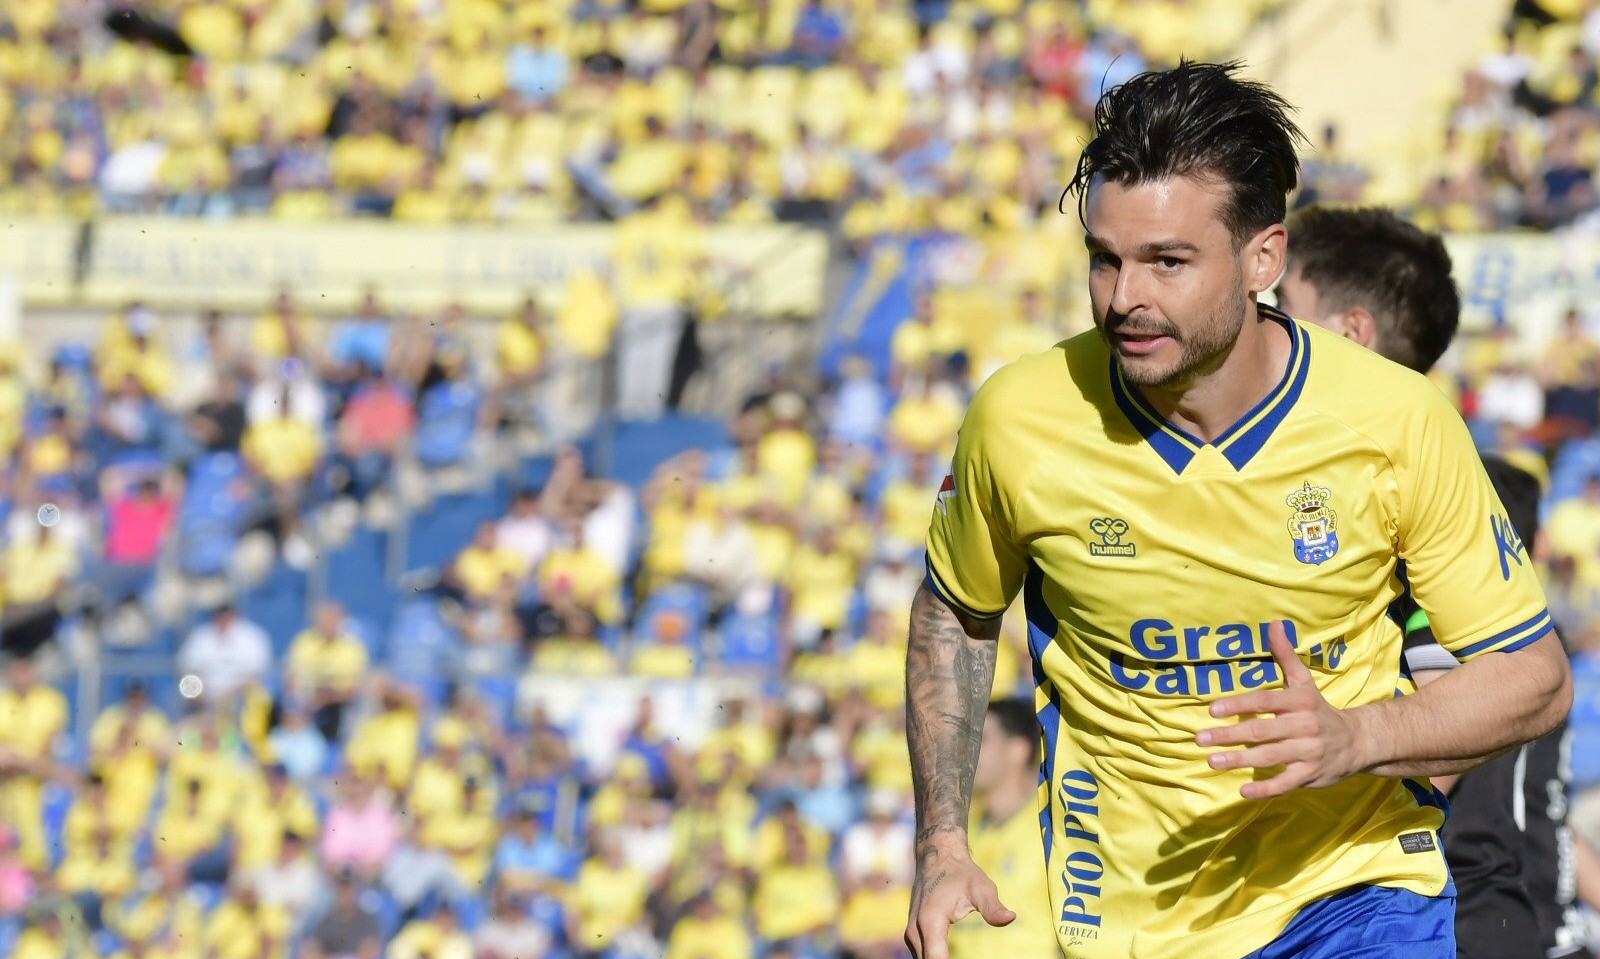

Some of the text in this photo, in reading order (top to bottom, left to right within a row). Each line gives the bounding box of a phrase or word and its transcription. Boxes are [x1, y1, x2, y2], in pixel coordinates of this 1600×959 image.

[1091, 543, 1135, 556] hummel
[1130, 618, 1298, 661] Gran
[1109, 634, 1349, 696] Canaia
[1059, 924, 1098, 940] CERVEZA
